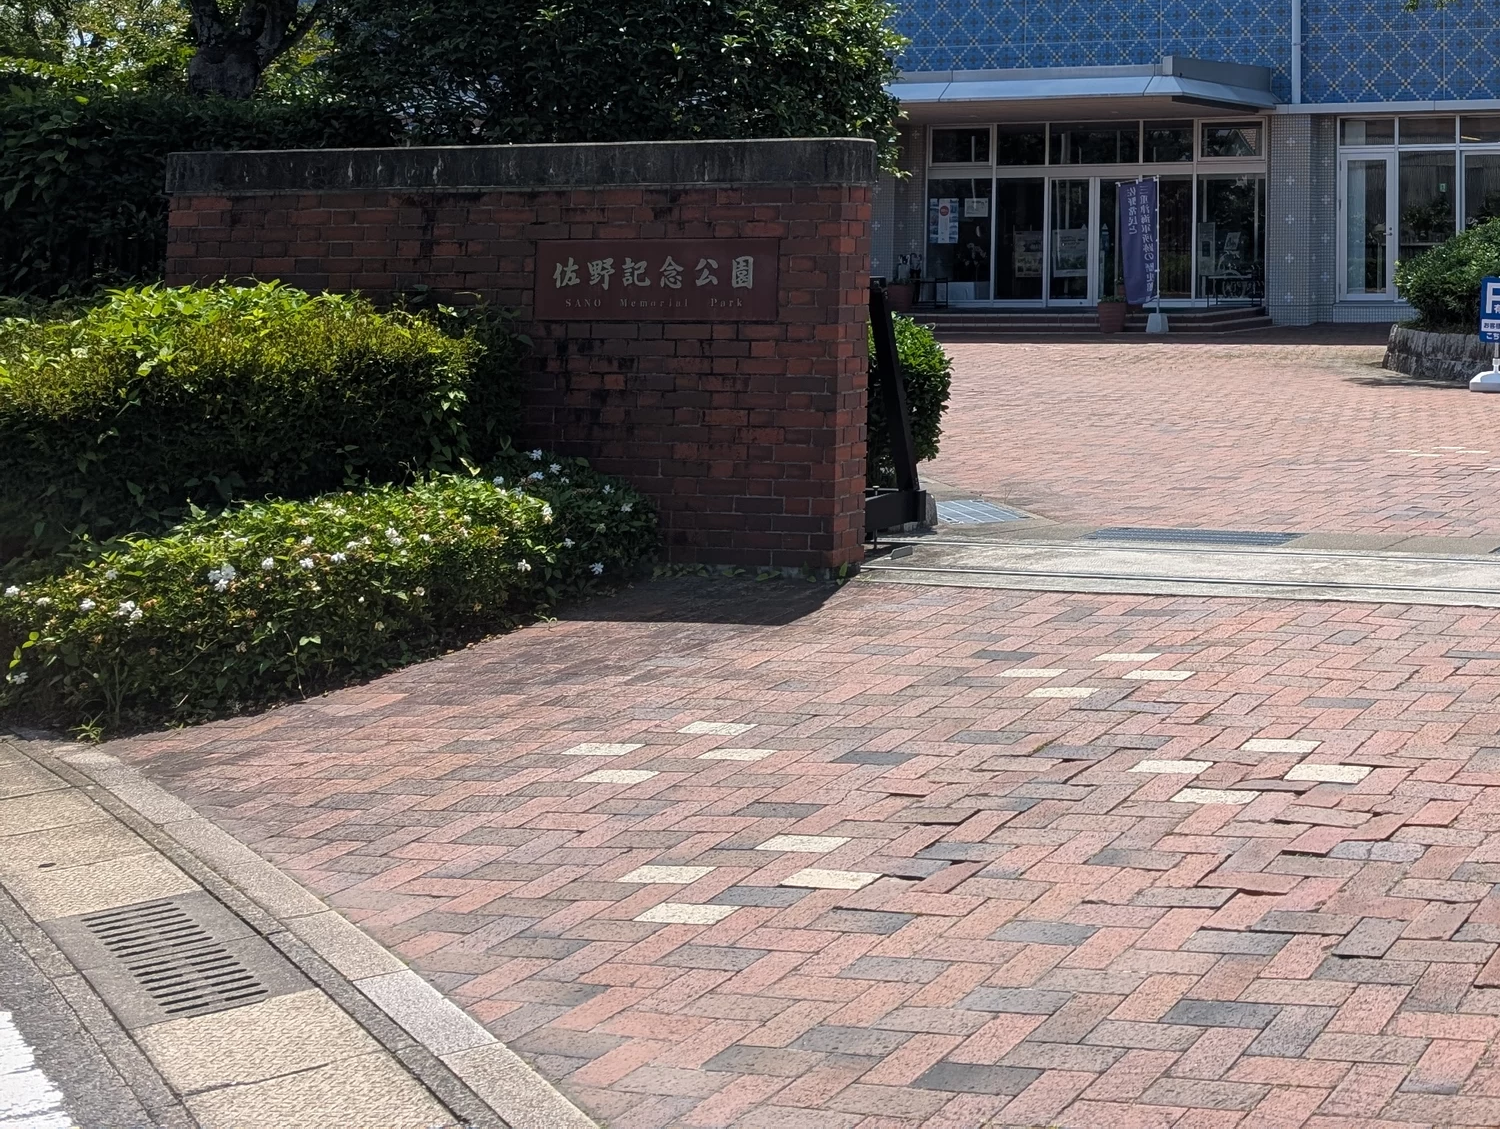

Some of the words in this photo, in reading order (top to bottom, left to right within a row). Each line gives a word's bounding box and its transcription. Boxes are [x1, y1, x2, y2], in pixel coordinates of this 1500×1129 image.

[553, 256, 754, 290] 佐野記念公園
[565, 299, 602, 307] SANO
[620, 298, 689, 307] Memorial
[710, 298, 743, 307] Park
